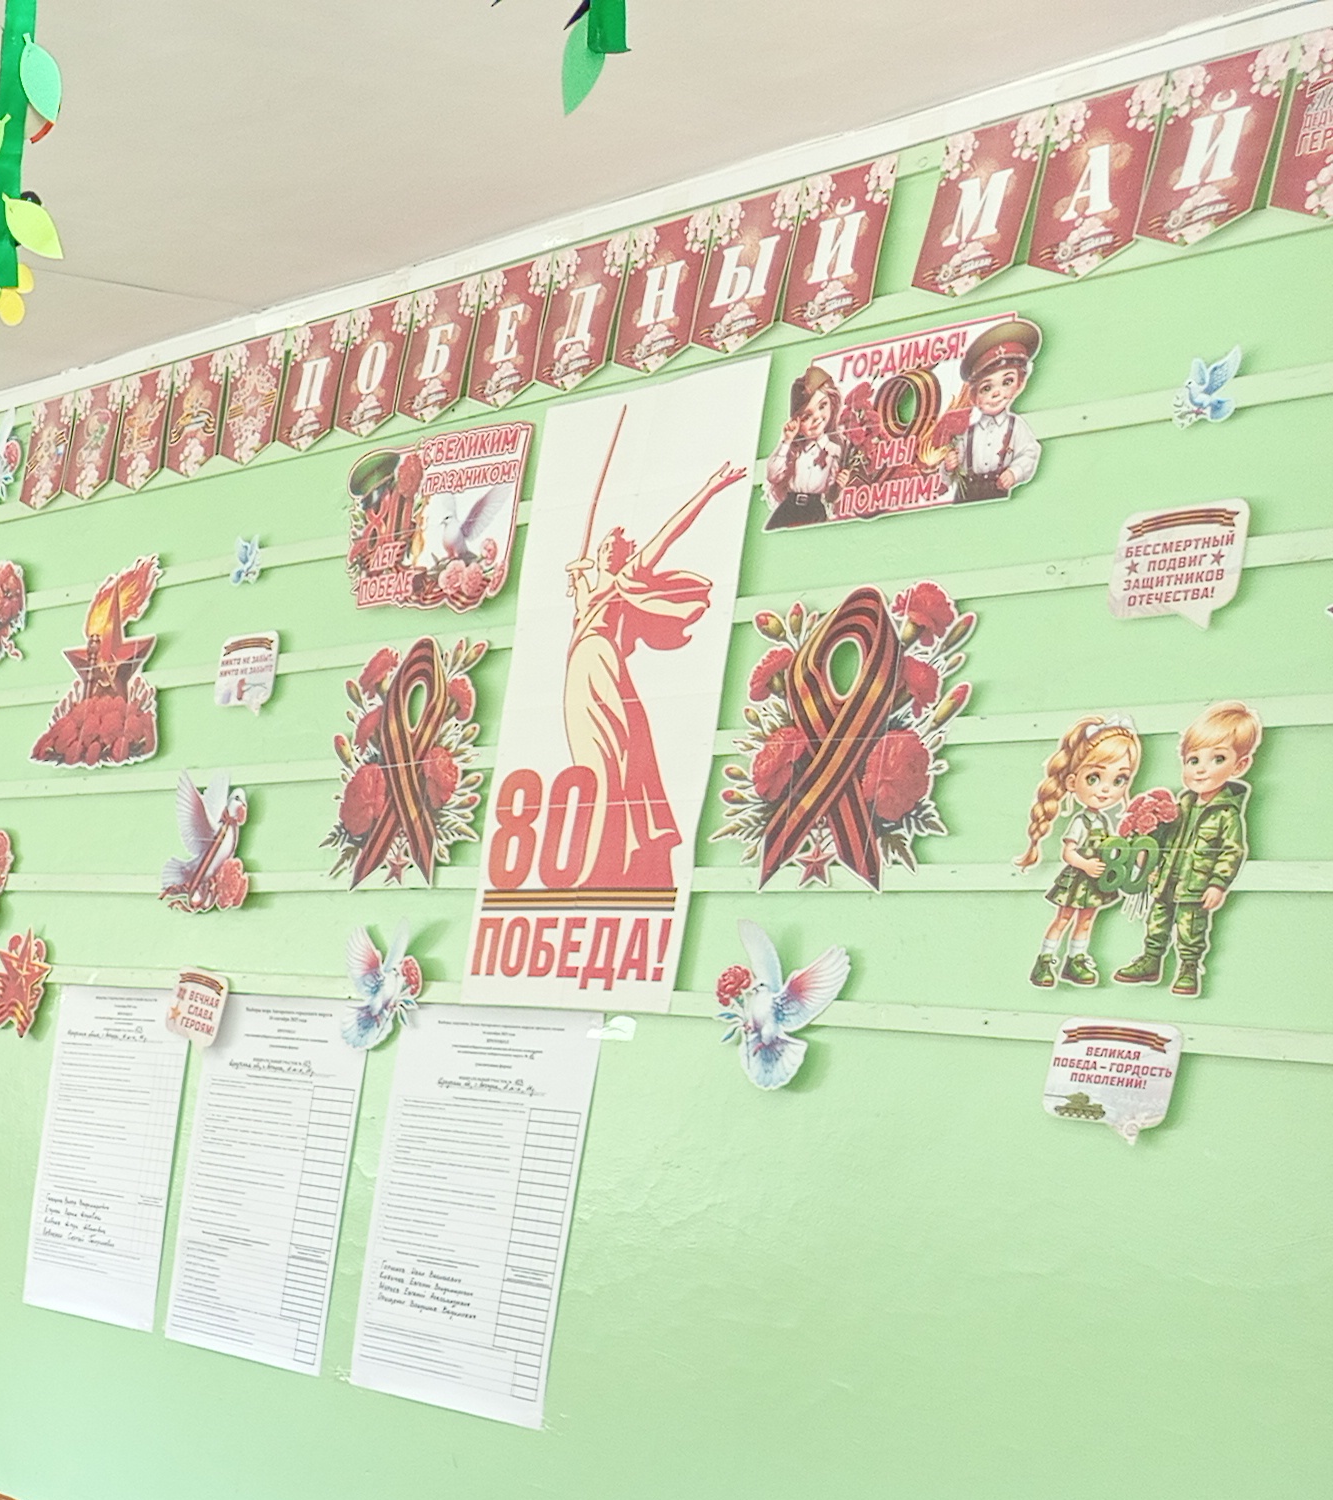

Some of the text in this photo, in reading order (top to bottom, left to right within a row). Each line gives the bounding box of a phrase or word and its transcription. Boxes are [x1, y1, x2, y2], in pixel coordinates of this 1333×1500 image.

[292, 88, 1252, 412] ПОБЕДНЫЙ МАЙ
[839, 331, 967, 382] ГОРДИМСЯ!
[434, 428, 521, 463] ВЕЛИКИМ
[876, 436, 917, 469] МЫ
[425, 462, 520, 493] ПРАЗДНИКОМ!
[840, 474, 943, 517] ПОМНИМ!
[369, 542, 406, 568] ЛЕТ
[1125, 530, 1235, 558] БЕССМЕРТНЫЙ
[1147, 553, 1207, 572] ПОДВИГ
[359, 572, 414, 602] ПОБЕДЕ
[1123, 568, 1225, 591] ЗАЩИТНИКОВ
[1127, 586, 1215, 607] ОТЕЧЕСТВА!
[488, 765, 598, 889] 80
[1098, 836, 1159, 894] 80
[471, 916, 673, 991] ПОБЕДА!
[188, 1004, 214, 1021] СЛАВА
[189, 990, 221, 1008] ВЕЧНАЯ
[180, 1016, 215, 1036] ГЕРОЯМ!
[1053, 1057, 1097, 1071] ПОБЕДА
[1109, 1062, 1173, 1078] ГОРДОСТЬ
[1086, 1046, 1141, 1061] ВЕЛИКАЯ
[1070, 1072, 1147, 1090] ПОКОЛЕНИЙ!
